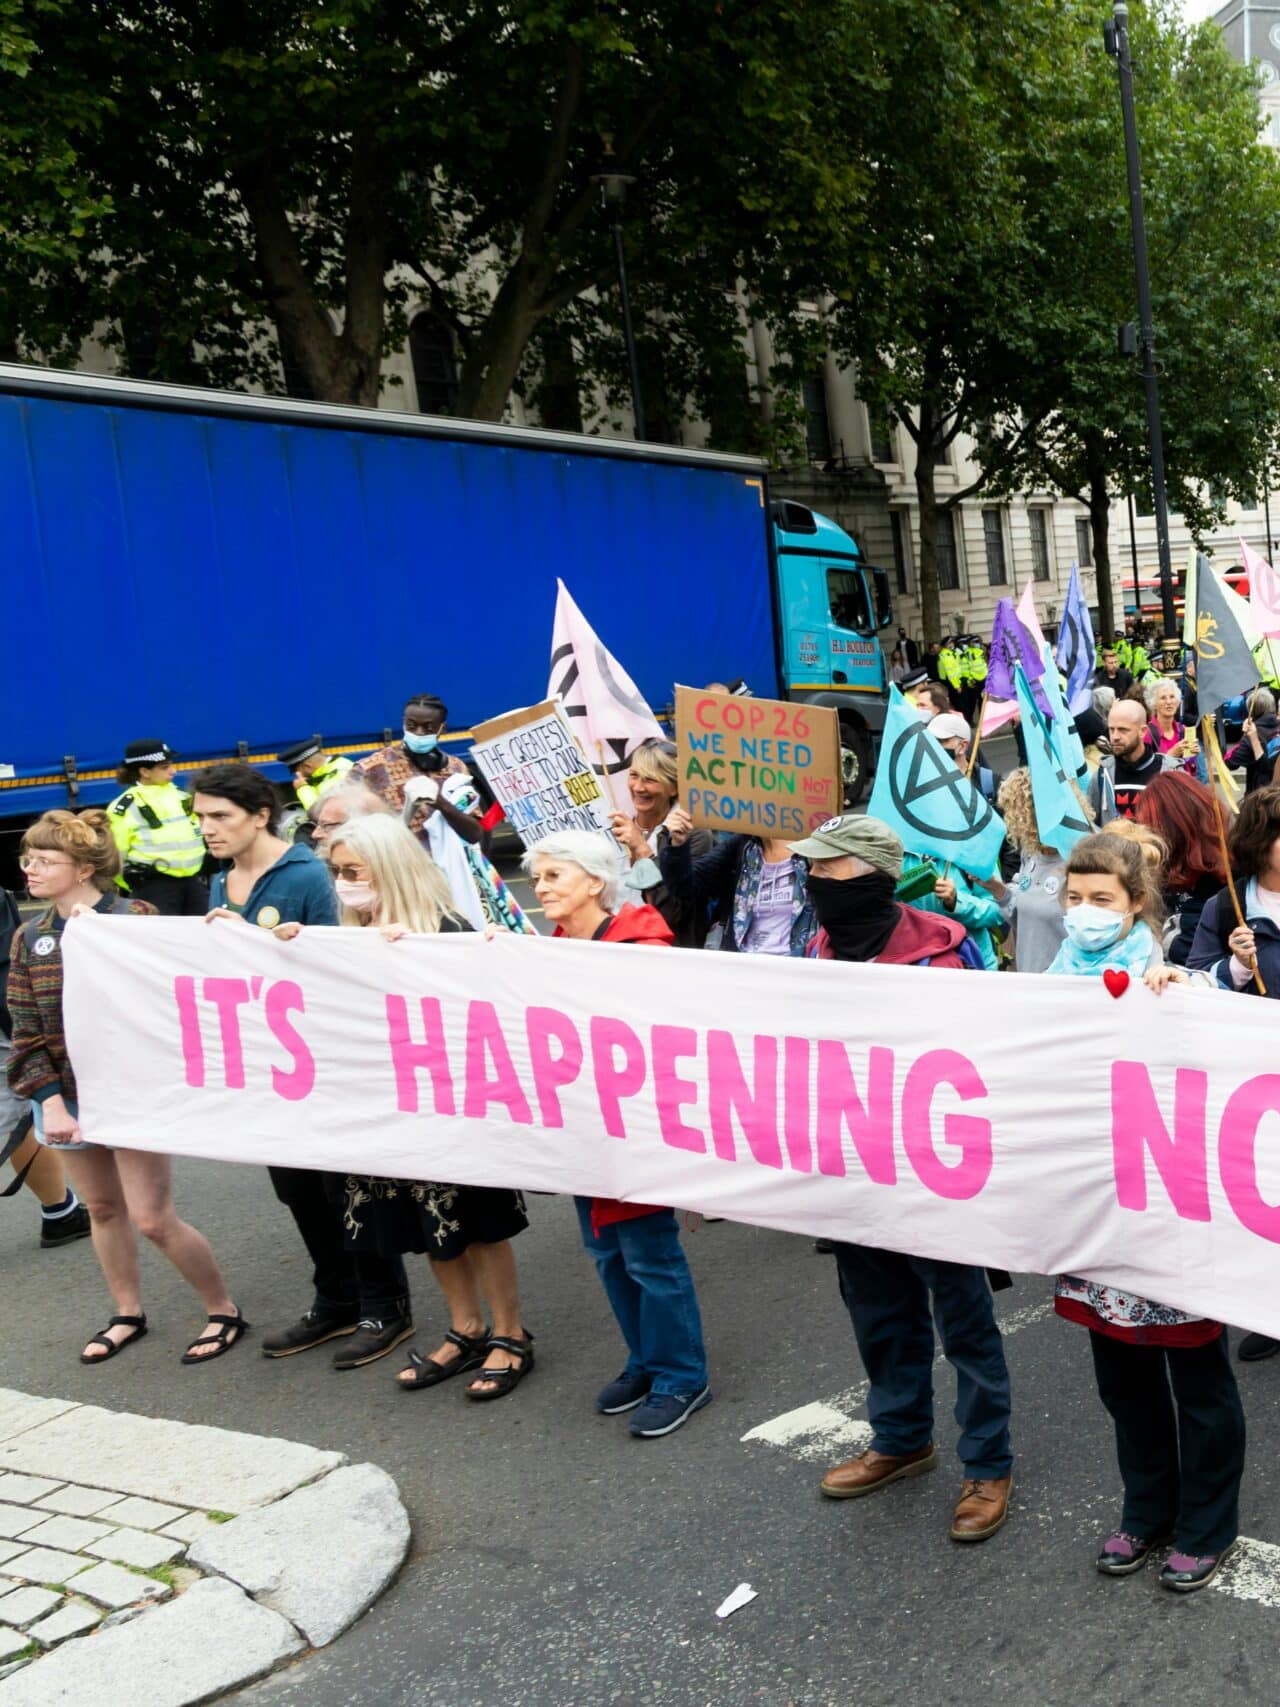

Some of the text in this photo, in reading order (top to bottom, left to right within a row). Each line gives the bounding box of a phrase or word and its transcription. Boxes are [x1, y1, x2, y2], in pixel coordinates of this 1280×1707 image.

[695, 698, 811, 740] COP 26
[477, 719, 570, 776] THE GREATEST
[688, 732, 813, 768] WE NEED
[490, 746, 589, 802] THREAT TO OUR
[686, 755, 833, 795] ACTION NOT
[504, 793, 545, 829] PLANET
[688, 788, 805, 833] PROMISES
[175, 975, 317, 1102] IT'S
[386, 994, 993, 1201] HAPPENING
